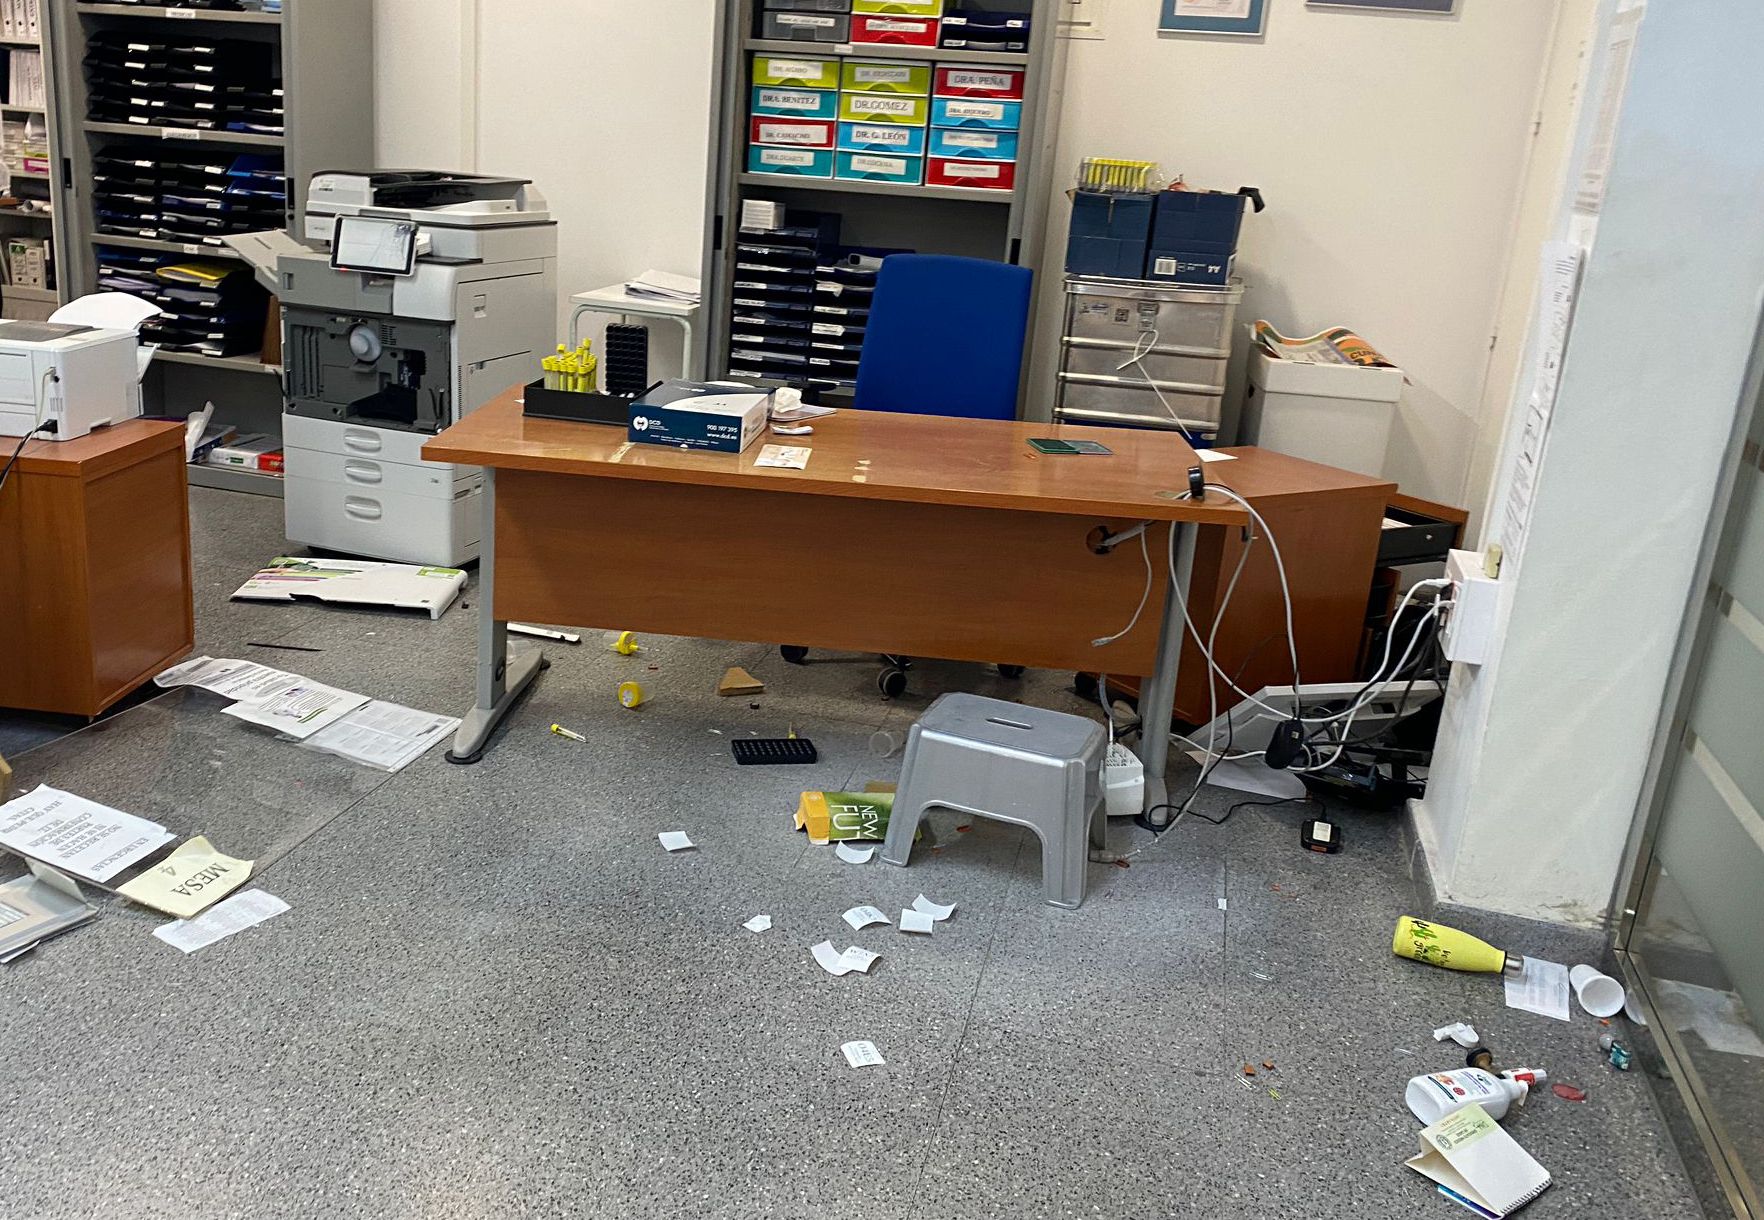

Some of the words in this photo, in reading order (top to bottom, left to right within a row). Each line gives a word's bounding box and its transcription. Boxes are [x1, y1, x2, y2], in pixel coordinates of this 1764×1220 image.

[979, 75, 1005, 86] PEÑA
[855, 130, 869, 139] DR.
[882, 129, 906, 141] LEÓN
[707, 424, 717, 432] 900
[718, 425, 728, 433] 197
[728, 426, 738, 434] 395
[859, 805, 878, 839] NEW
[157, 866, 176, 877] 4
[170, 863, 230, 897] MESA
